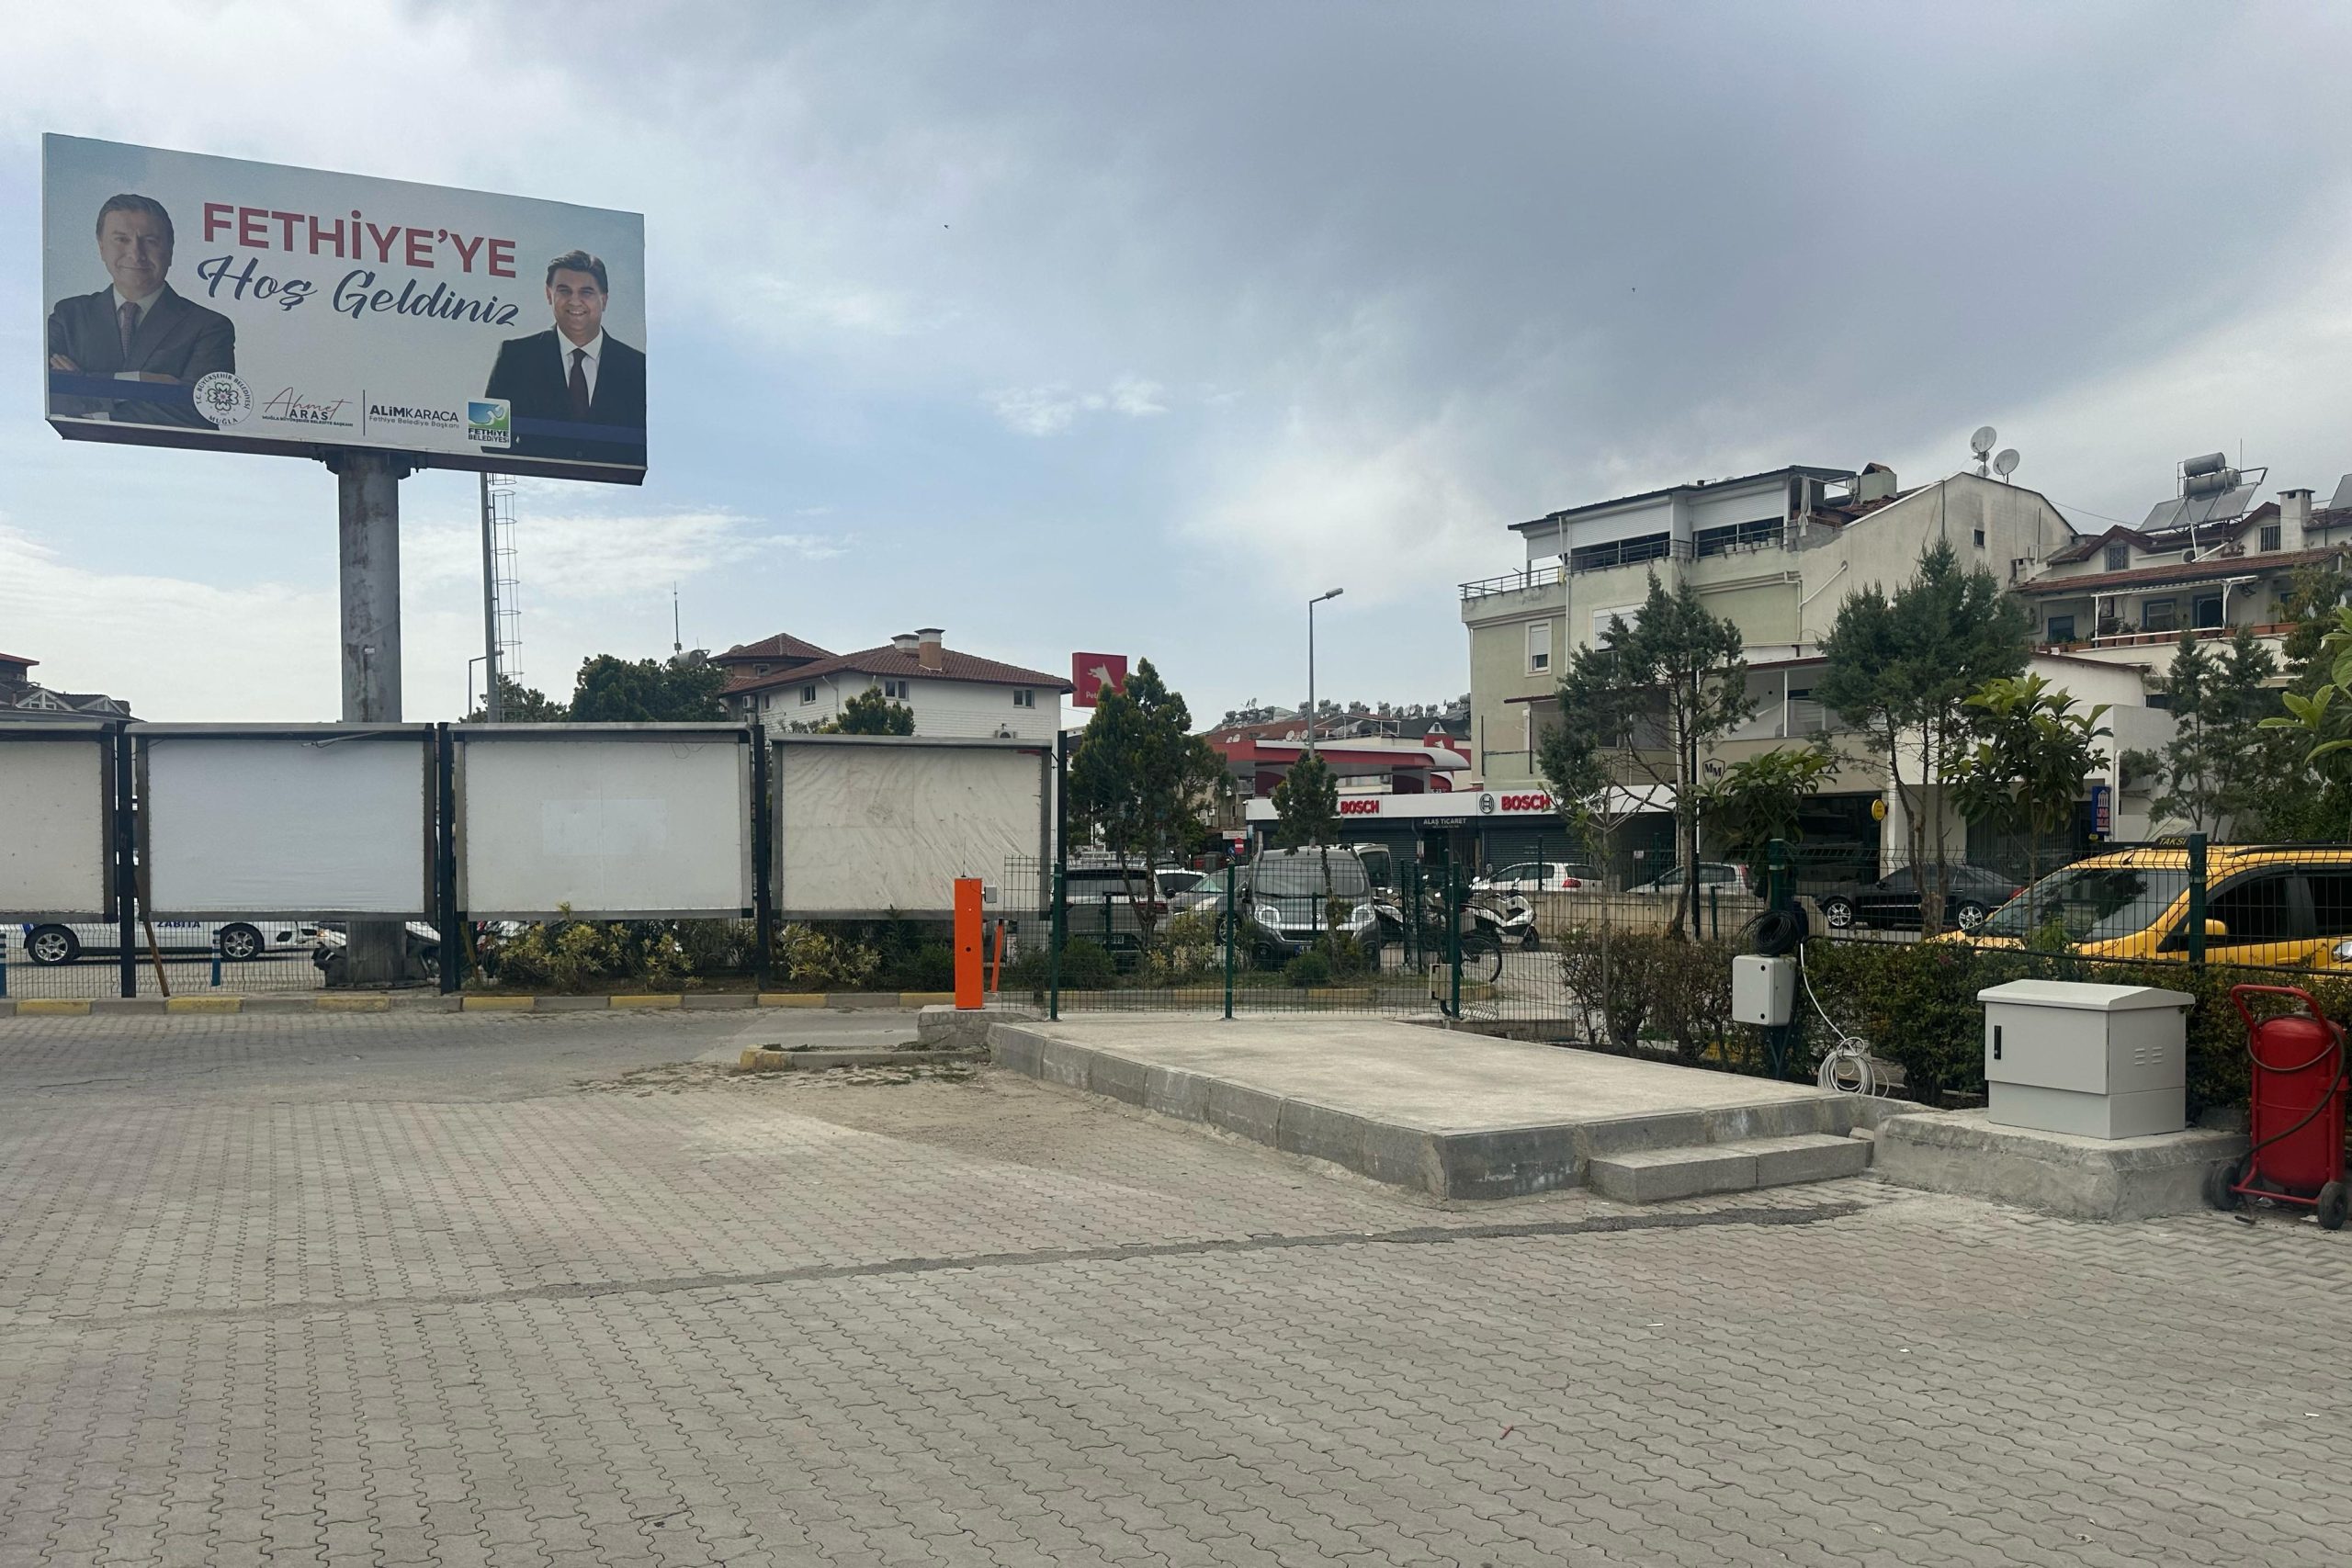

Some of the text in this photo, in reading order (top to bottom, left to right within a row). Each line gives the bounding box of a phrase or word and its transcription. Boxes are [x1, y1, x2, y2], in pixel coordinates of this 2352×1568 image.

[197, 254, 520, 327] Hoş Geldiniz
[288, 409, 329, 421] ARAS
[368, 415, 396, 424] Fethiye
[397, 417, 430, 427] Belediye
[1340, 799, 1380, 815] BOSCH
[1500, 794, 1552, 811] BOSCH
